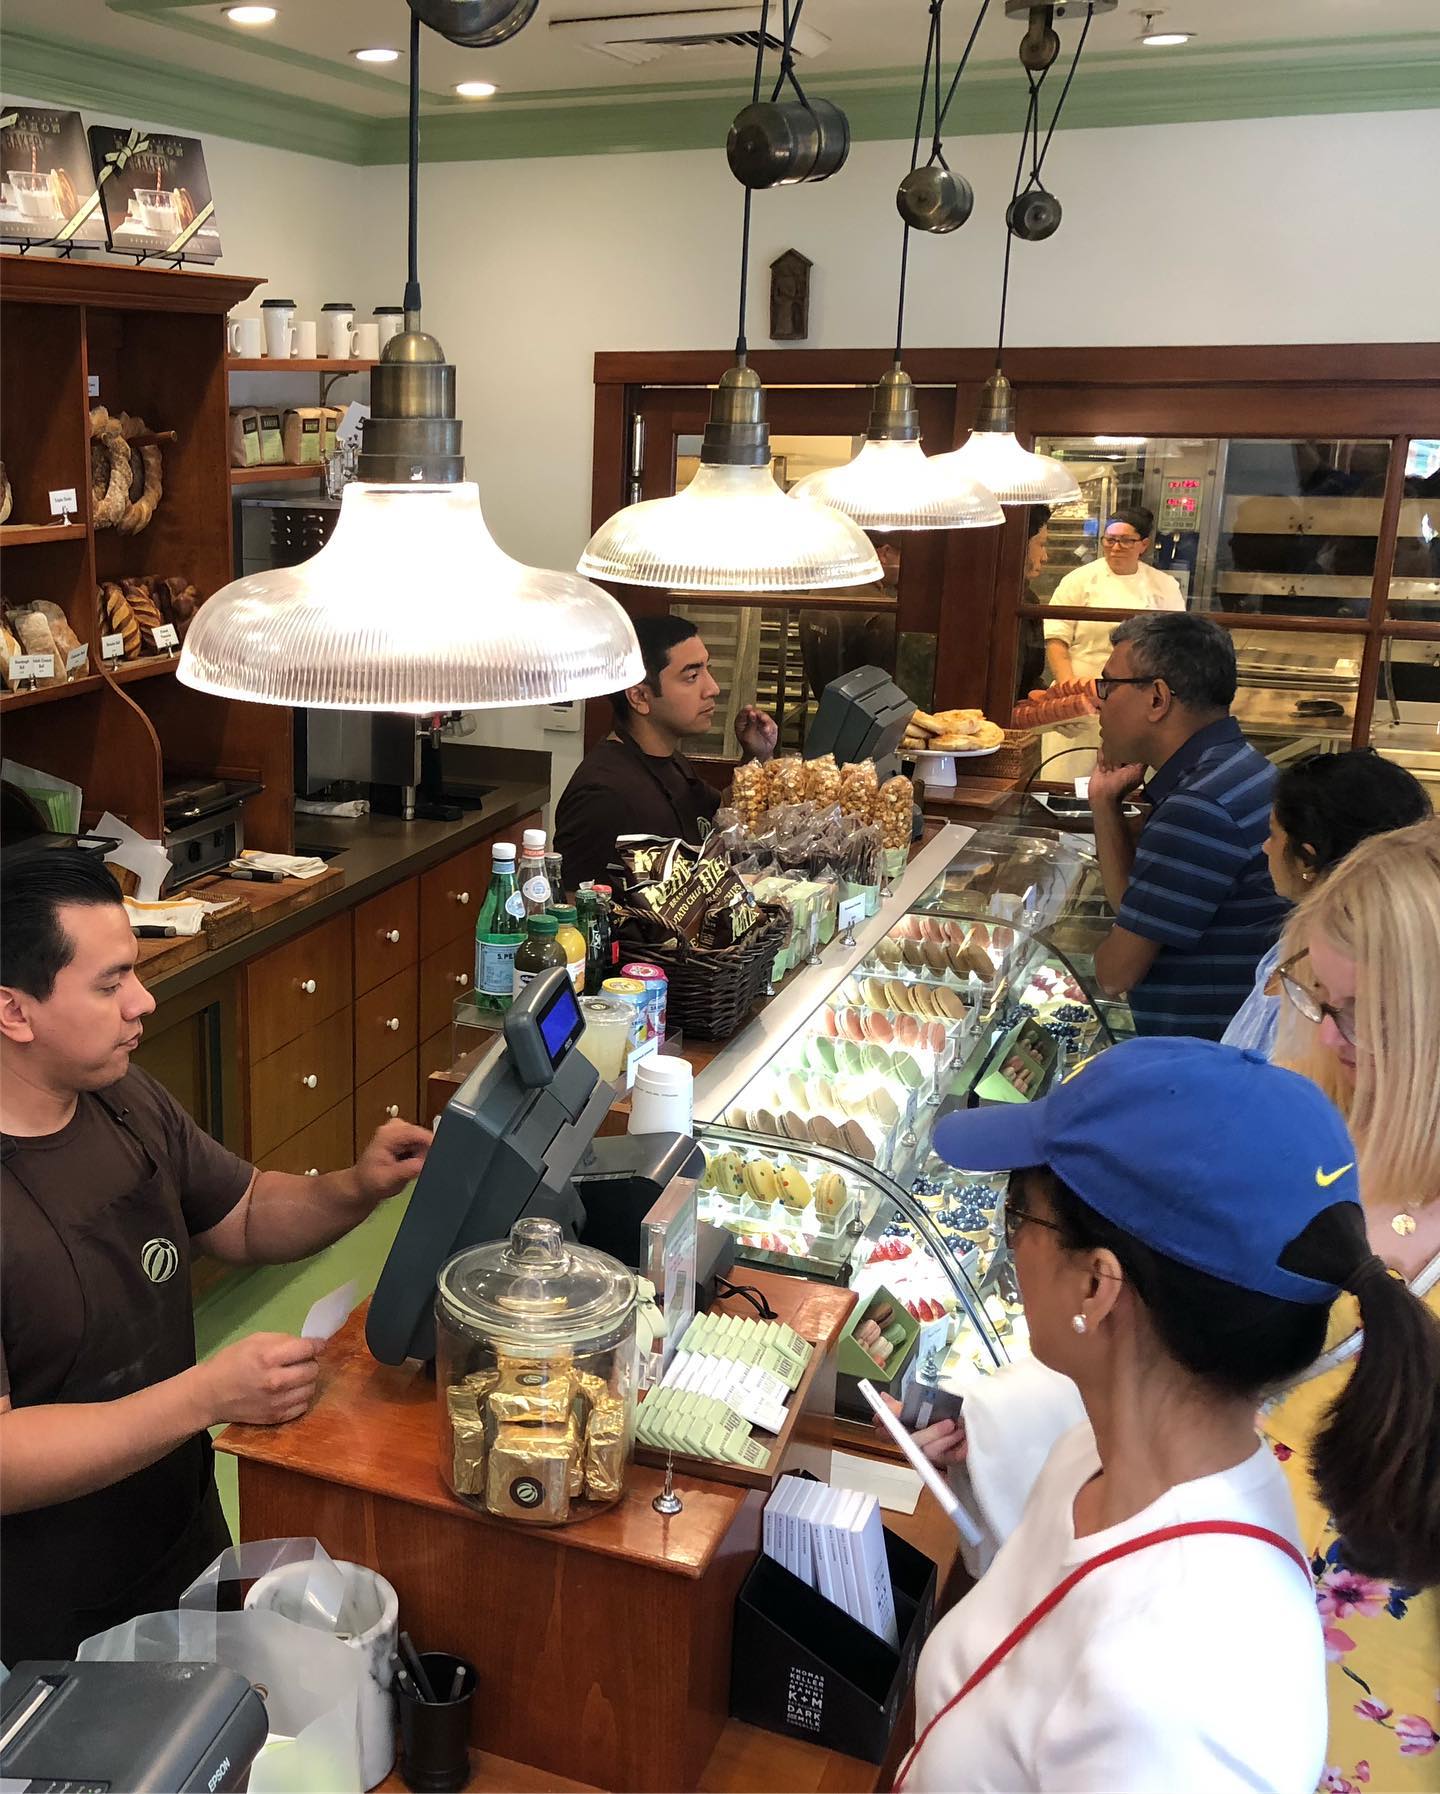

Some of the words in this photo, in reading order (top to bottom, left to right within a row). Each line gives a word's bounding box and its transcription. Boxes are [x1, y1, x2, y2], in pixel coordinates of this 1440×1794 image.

[355, 416, 366, 431] 5
[668, 887, 688, 908] BRAND
[672, 903, 689, 925] OTATO
[790, 1672, 824, 1689] KELLER
[791, 1666, 825, 1682] THOMAS
[789, 1684, 823, 1700] MANNI
[788, 1704, 821, 1722] DARK
[798, 1715, 821, 1728] MILK
[208, 1756, 230, 1793] EPSON
